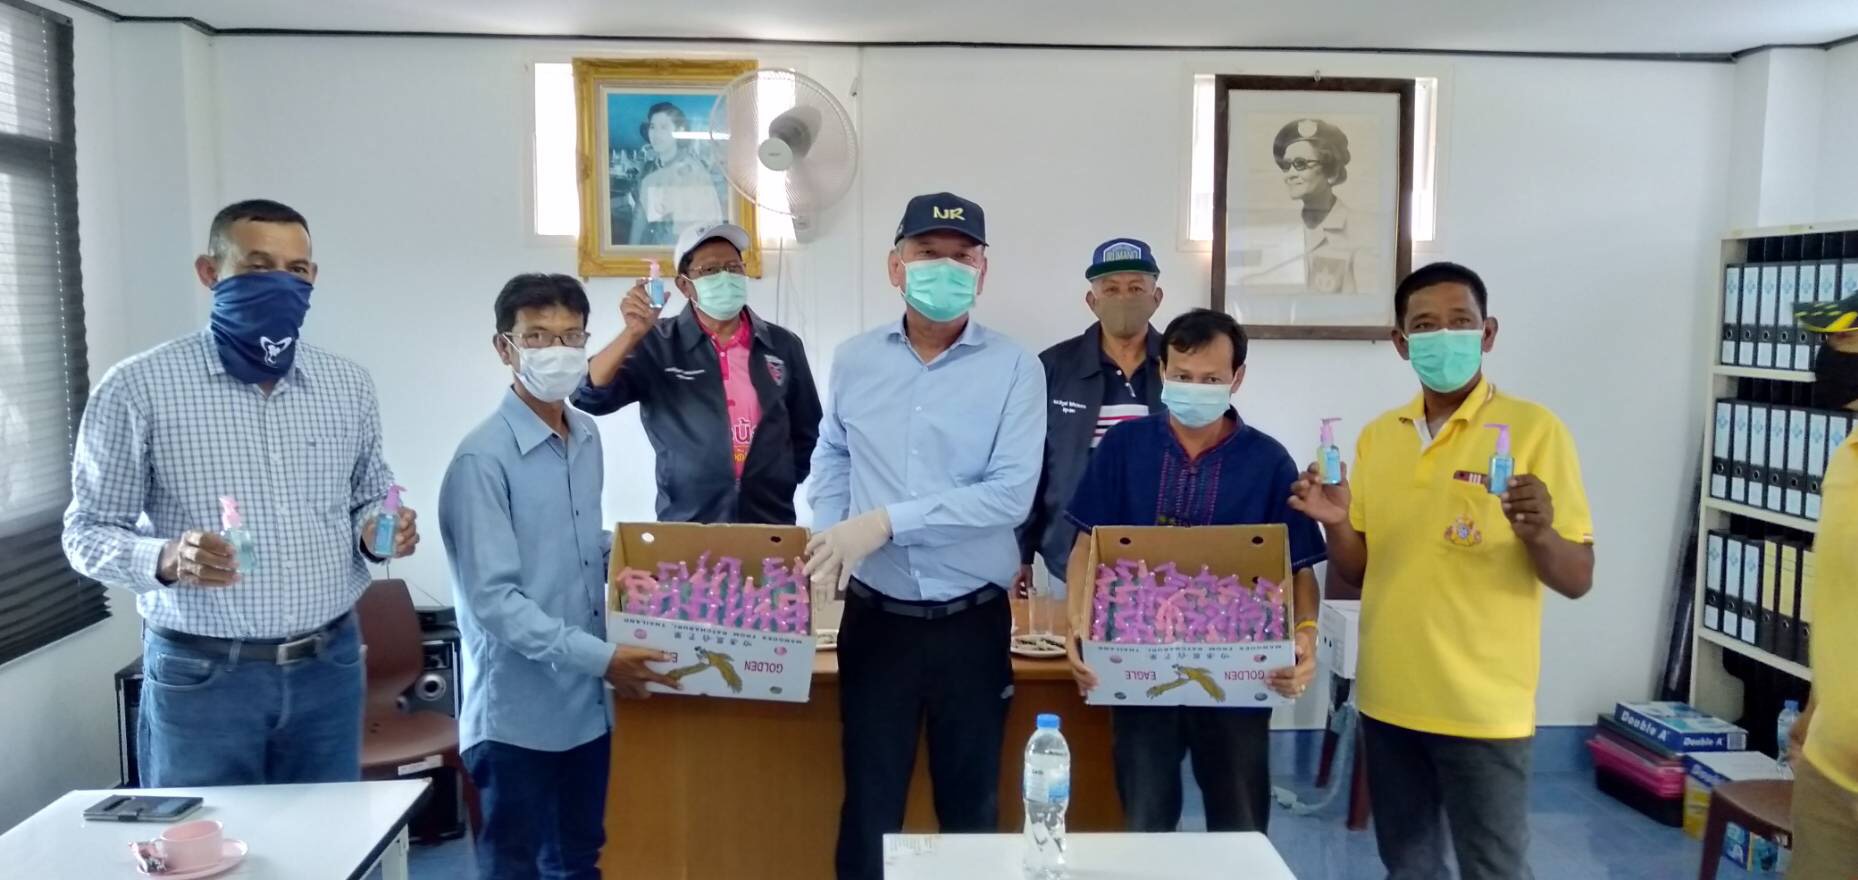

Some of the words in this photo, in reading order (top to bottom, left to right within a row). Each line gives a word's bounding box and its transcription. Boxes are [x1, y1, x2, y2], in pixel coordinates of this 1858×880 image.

[933, 206, 966, 220] NR
[744, 660, 784, 674] GOLDEN
[1126, 671, 1157, 681] EAGLE
[1224, 670, 1265, 681] GOLDEN
[1621, 710, 1657, 736] Double
[1657, 729, 1667, 742] A
[1683, 737, 1714, 746] Double
[1715, 738, 1723, 746] A
